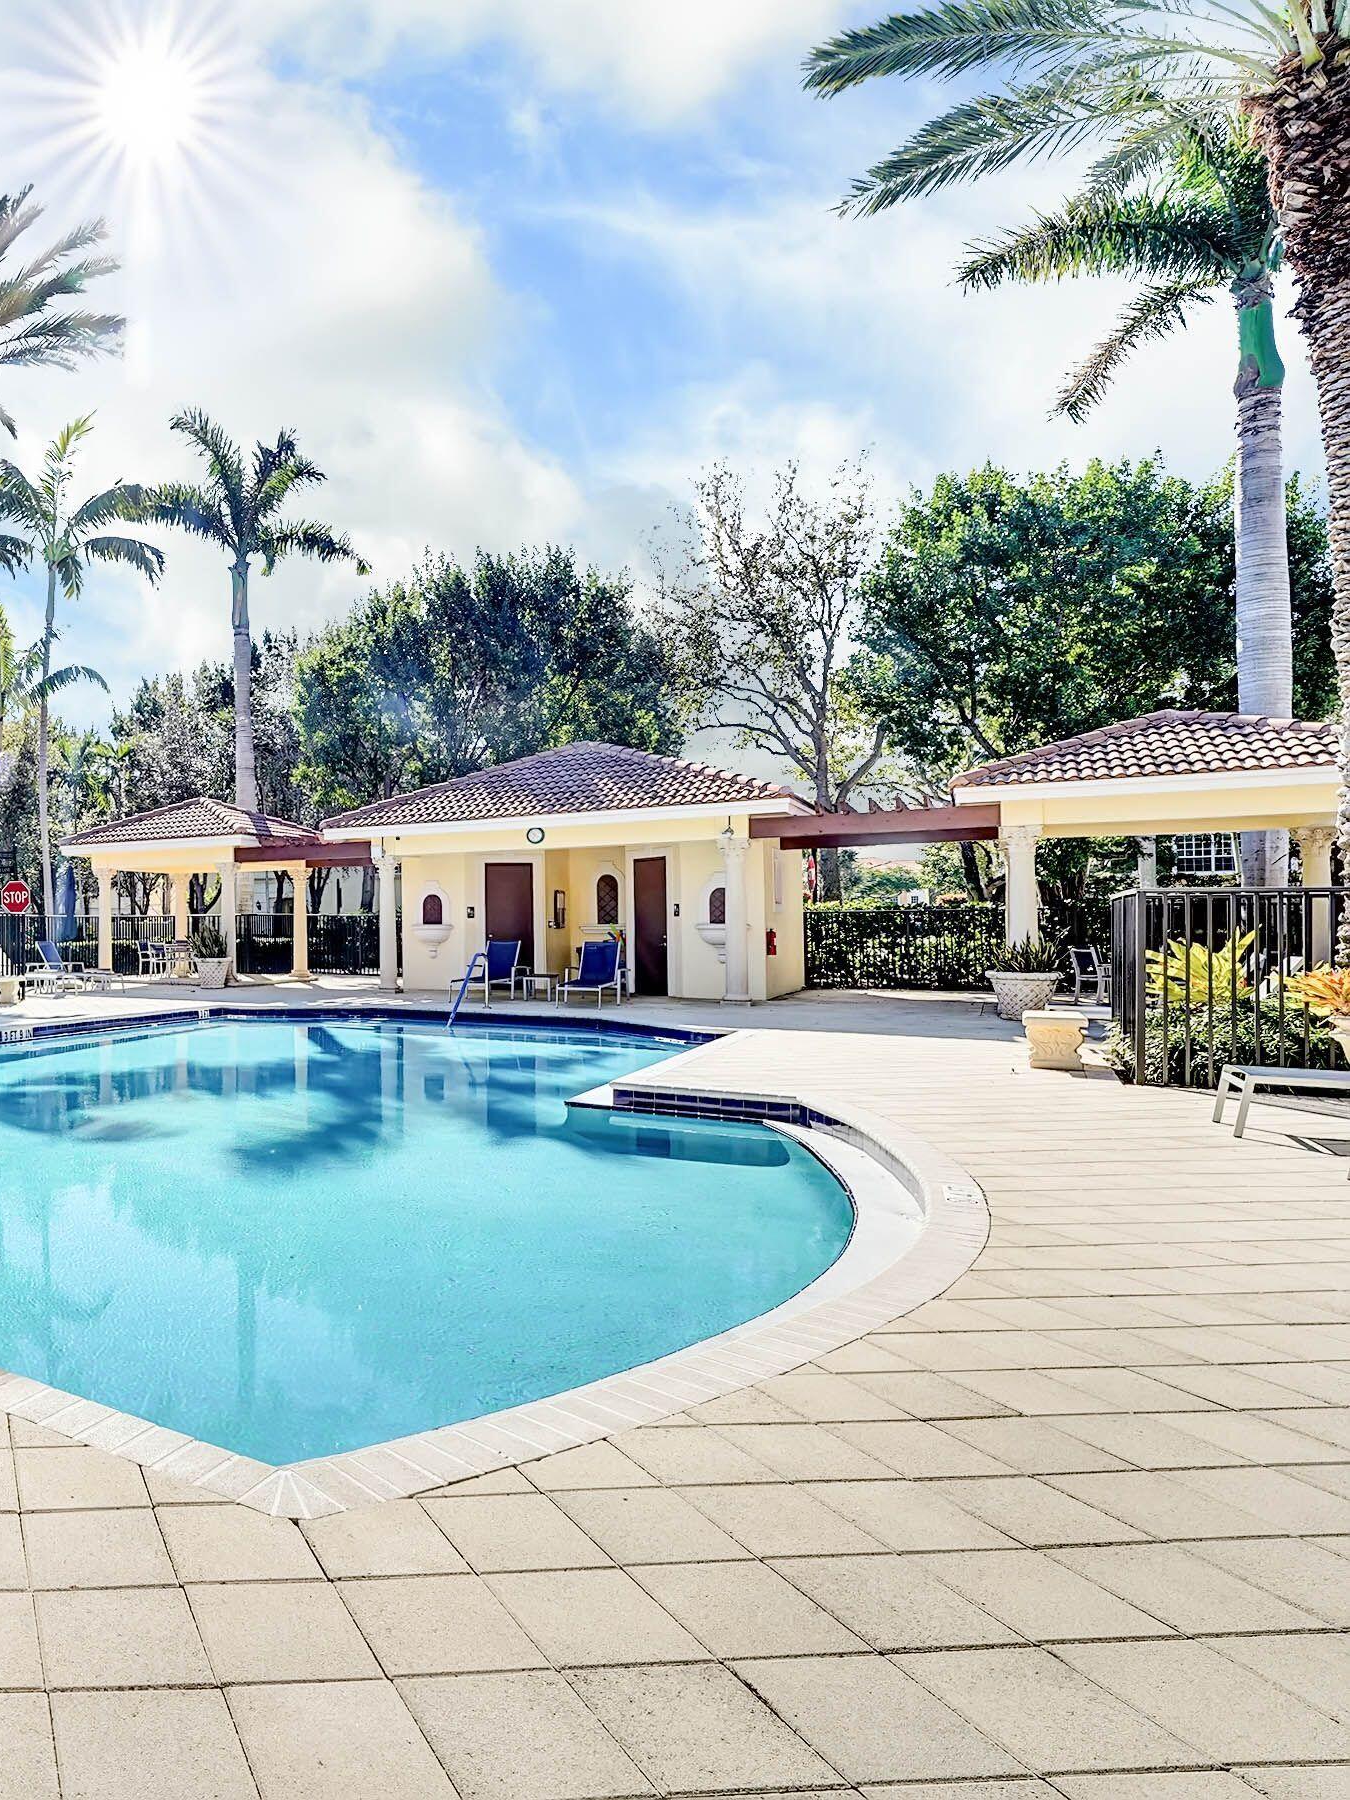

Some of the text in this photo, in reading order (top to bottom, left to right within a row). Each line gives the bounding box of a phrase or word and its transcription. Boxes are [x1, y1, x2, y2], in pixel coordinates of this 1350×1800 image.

[3, 891, 29, 904] STOP
[4, 1031, 8, 1041] 3
[9, 1030, 17, 1040] FT
[25, 1029, 32, 1039] IN
